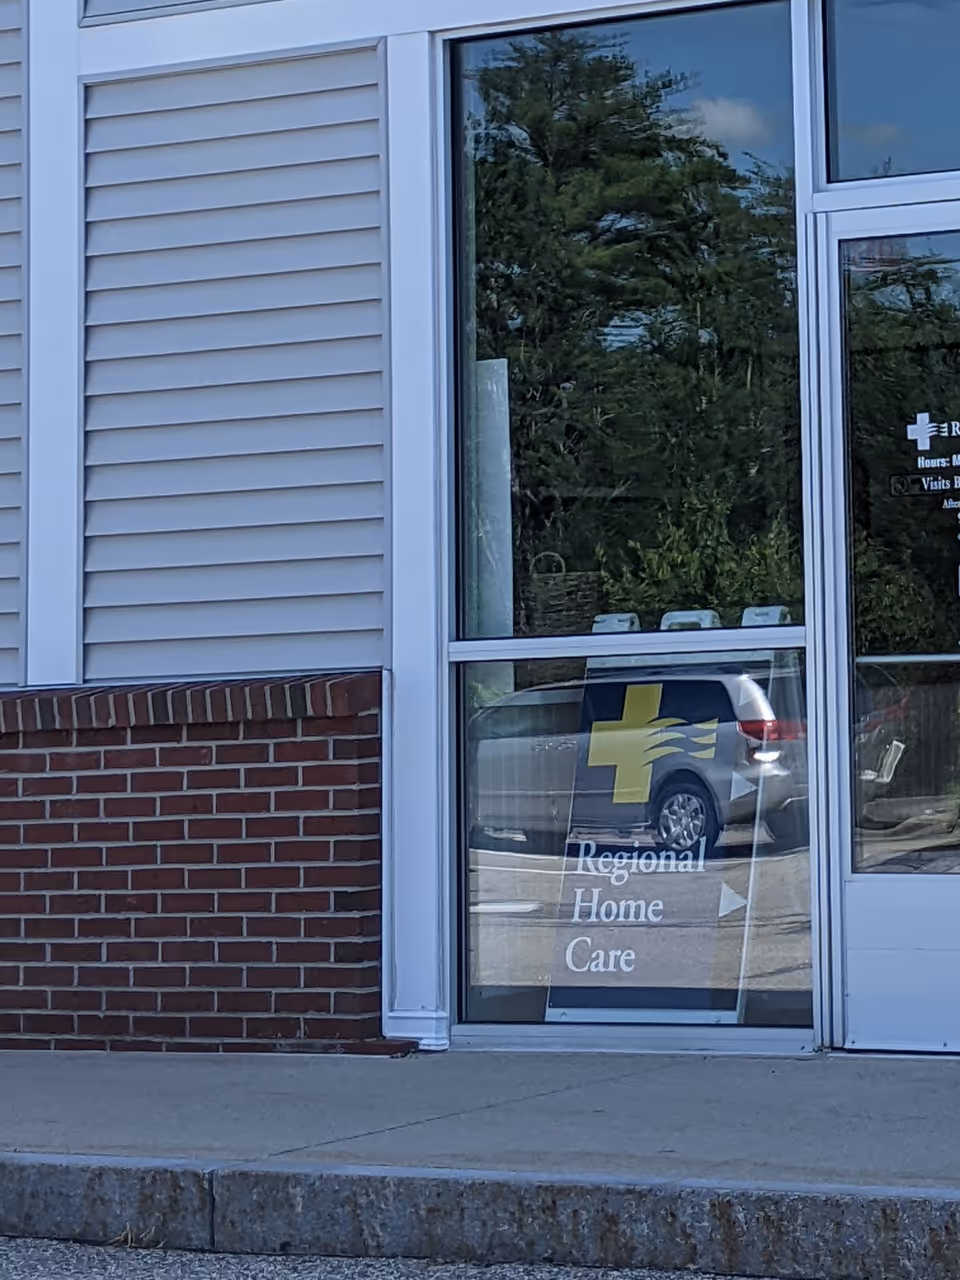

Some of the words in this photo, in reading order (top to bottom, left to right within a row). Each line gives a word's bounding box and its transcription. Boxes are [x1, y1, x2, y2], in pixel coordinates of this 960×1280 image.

[917, 456, 950, 469] Hours:
[922, 476, 951, 491] Visits
[942, 498, 960, 509] After
[577, 836, 708, 887] Regional
[571, 888, 664, 923] Home
[565, 936, 636, 973] Care
